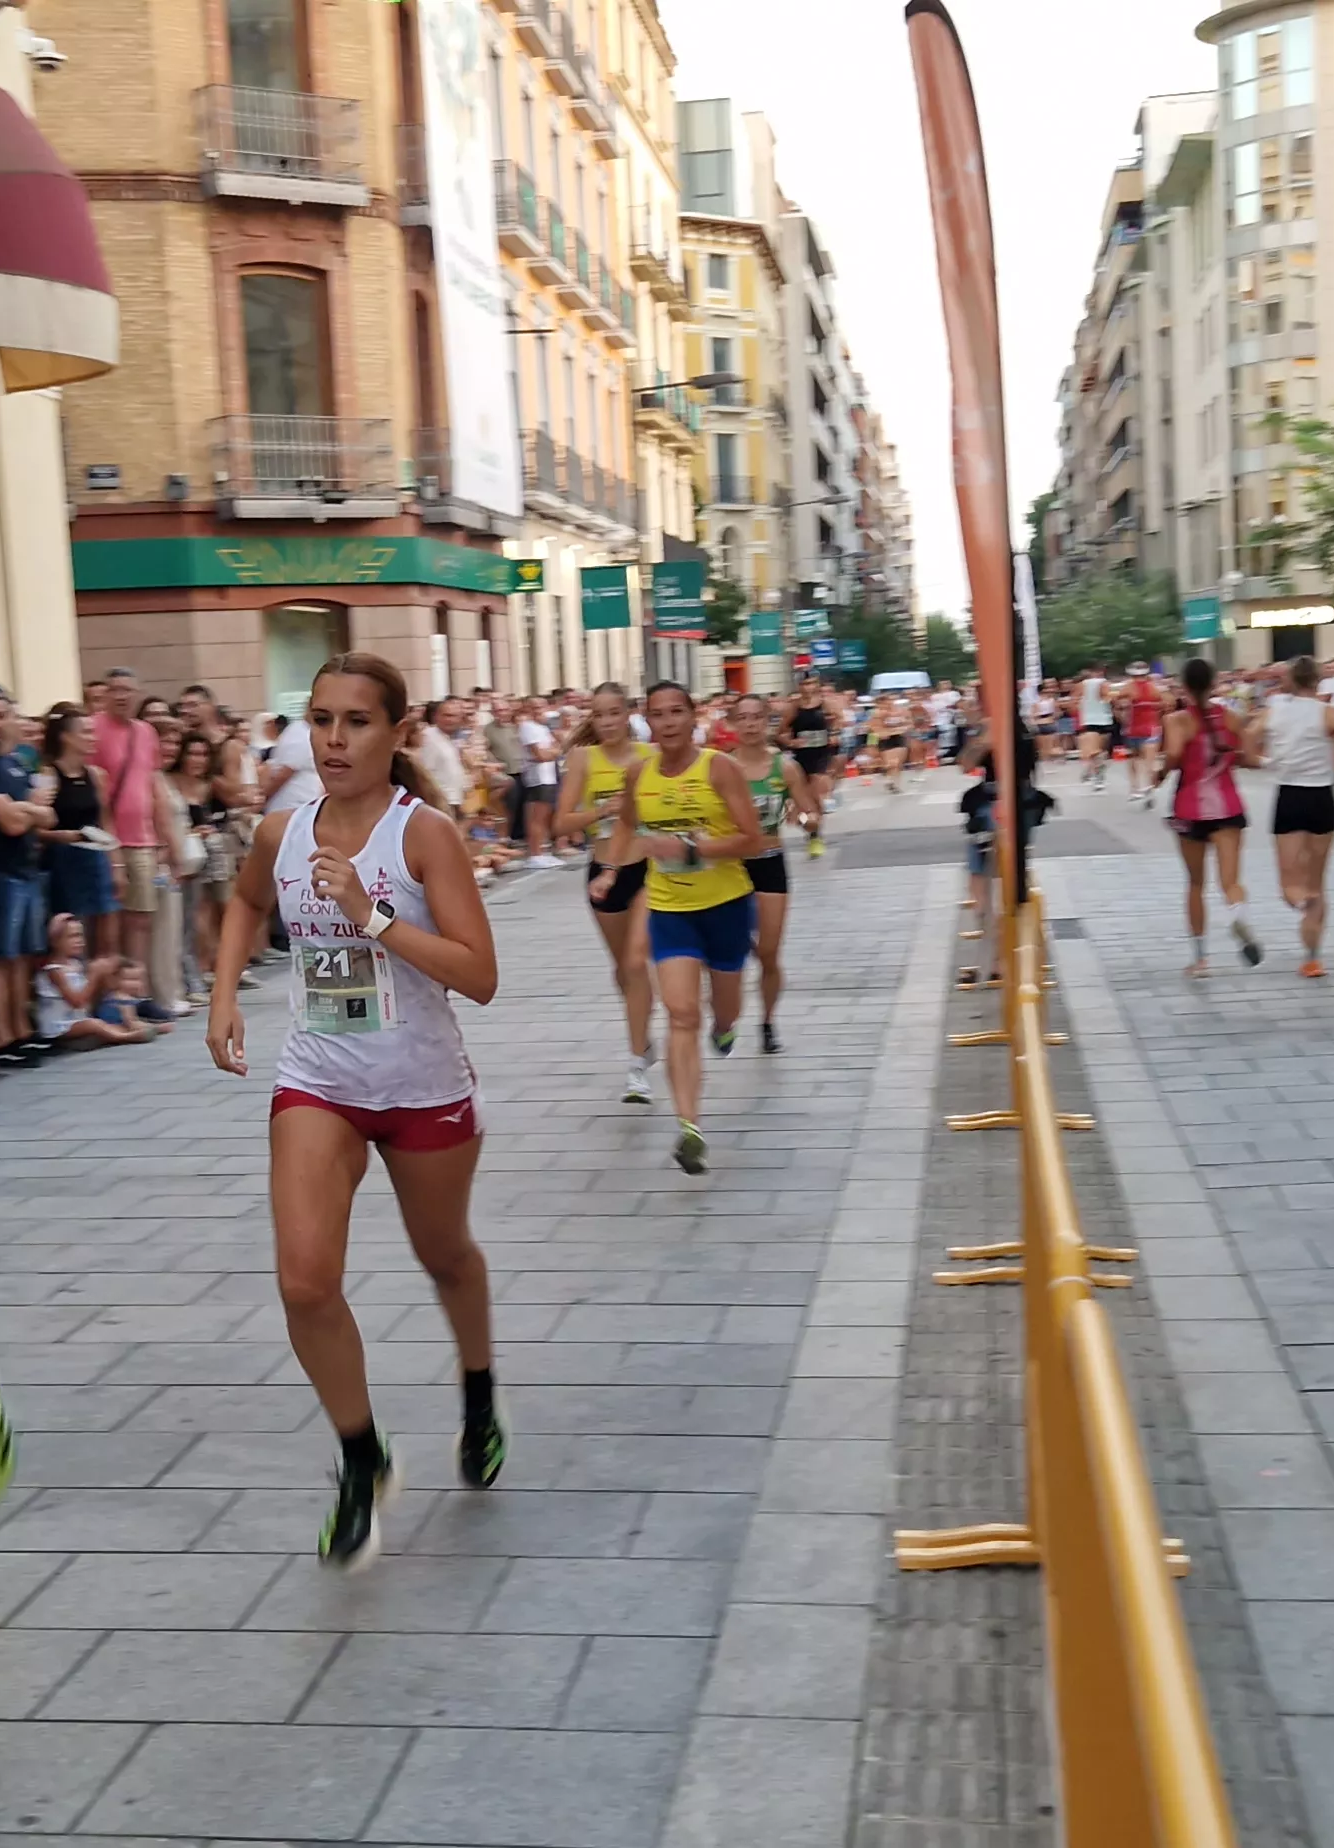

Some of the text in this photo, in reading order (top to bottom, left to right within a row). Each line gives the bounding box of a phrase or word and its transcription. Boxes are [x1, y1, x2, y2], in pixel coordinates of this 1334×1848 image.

[299, 901, 331, 915] CIÓN
[330, 922, 373, 939] ZUE
[315, 950, 351, 978] 21
